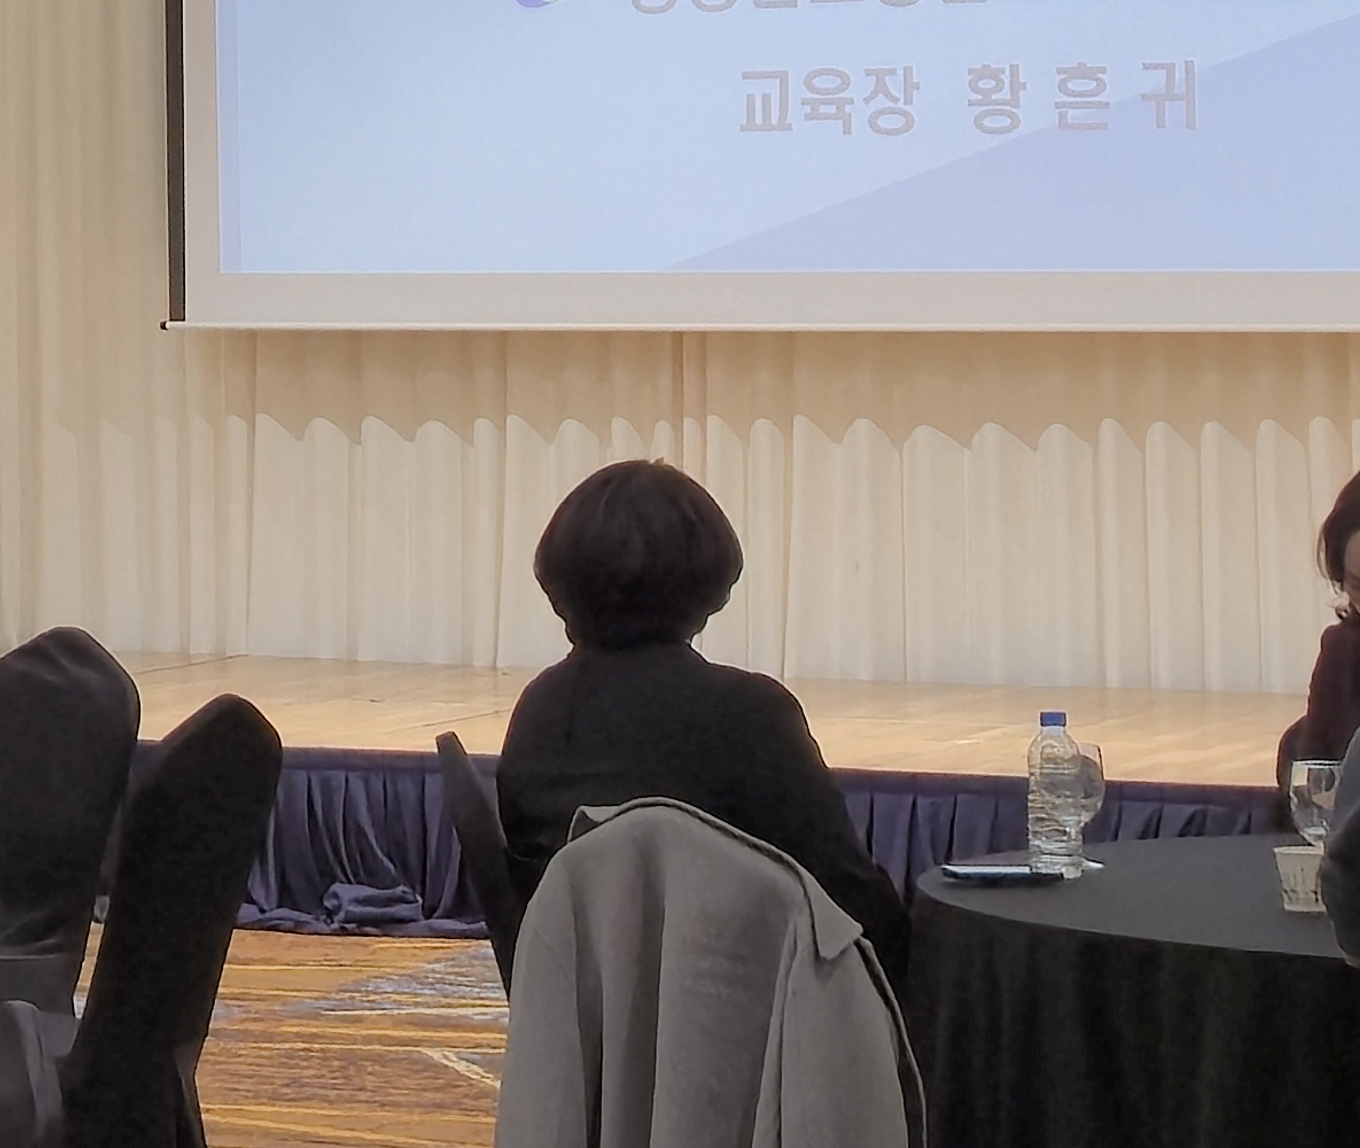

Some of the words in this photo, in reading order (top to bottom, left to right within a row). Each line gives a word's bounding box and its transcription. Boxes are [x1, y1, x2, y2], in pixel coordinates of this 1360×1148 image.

[739, 65, 921, 137] 교육장
[967, 62, 1028, 136] 황
[1054, 61, 1112, 133] 흔
[1141, 59, 1198, 131] 귀
